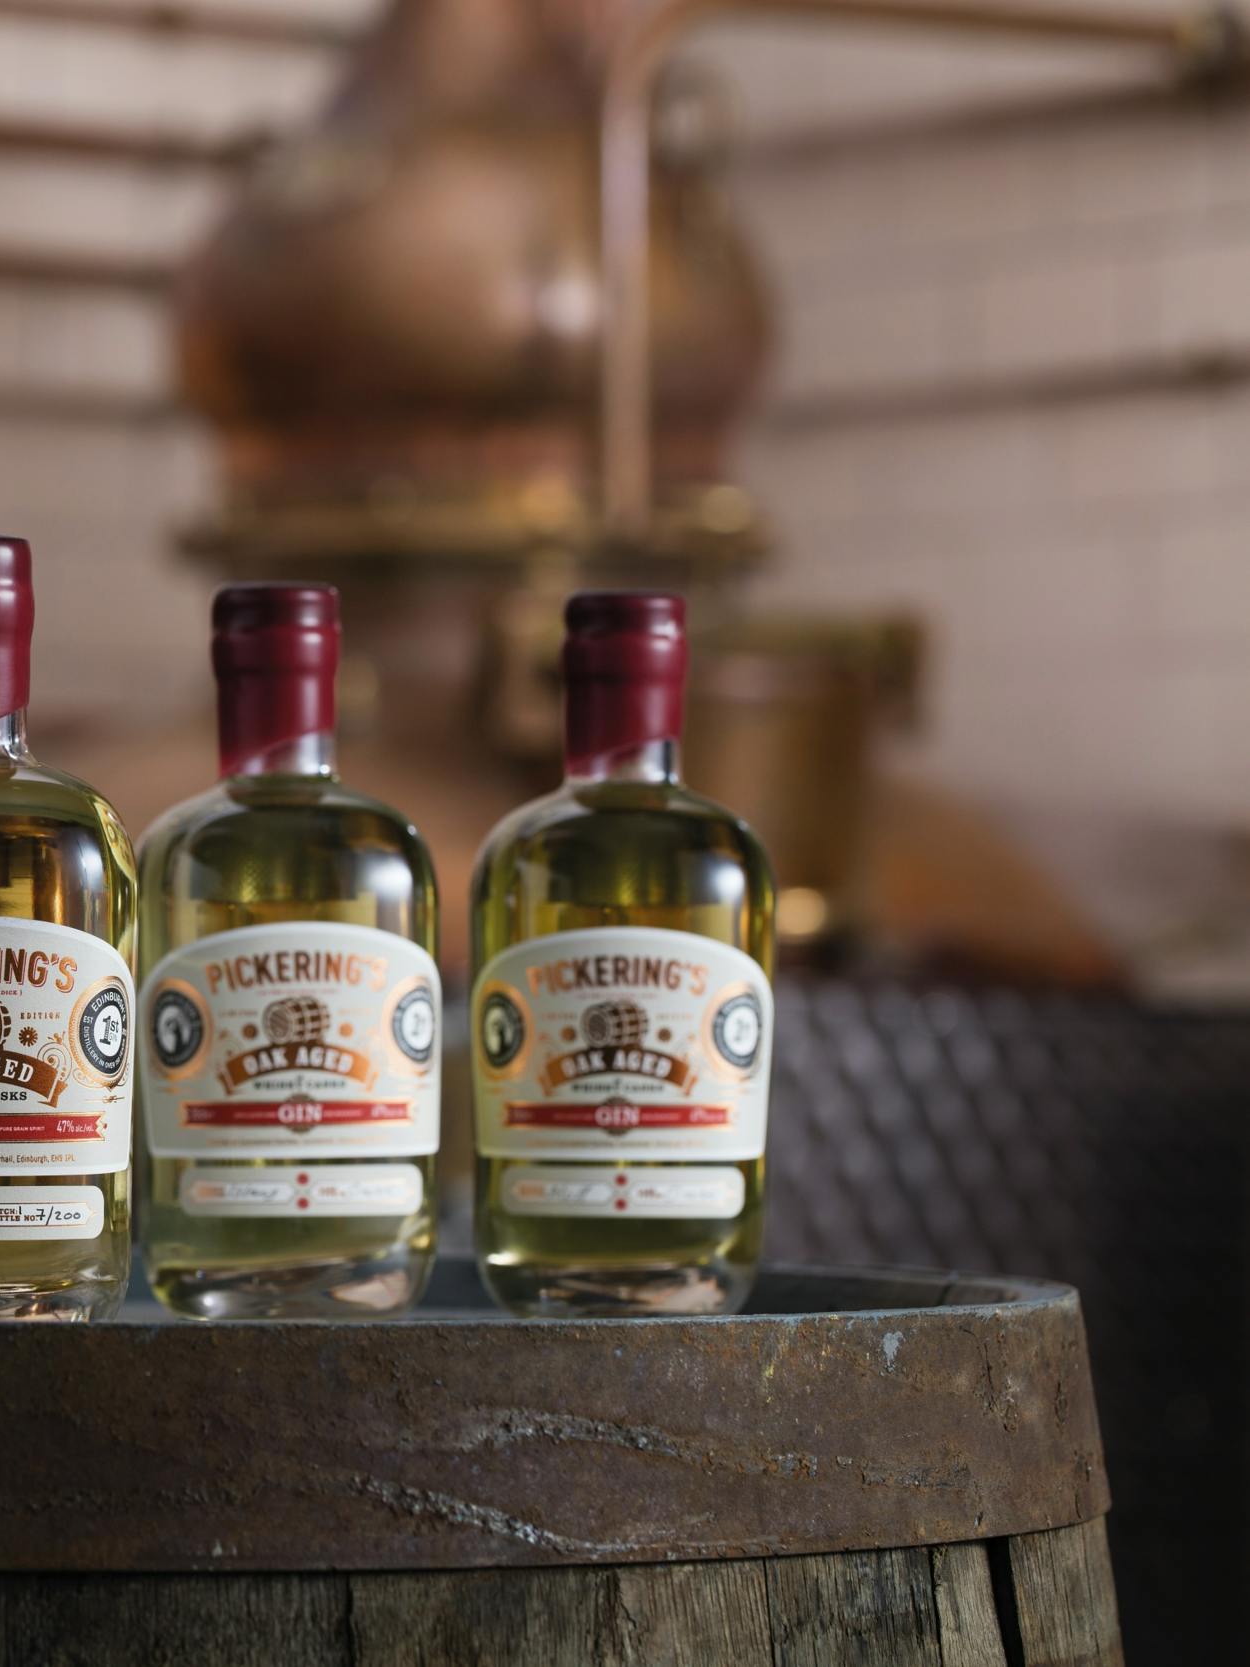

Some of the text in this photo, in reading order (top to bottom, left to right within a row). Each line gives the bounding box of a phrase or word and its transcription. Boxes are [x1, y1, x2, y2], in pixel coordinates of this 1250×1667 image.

[205, 950, 388, 994] PICKERING'S
[526, 955, 710, 996] PICKERING'S
[20, 1011, 61, 1020] EDITION
[243, 1046, 354, 1075] OAK AGED
[560, 1050, 673, 1078] OAK AGED
[277, 1103, 324, 1124] GIN
[595, 1106, 641, 1127] GIN
[56, 1120, 75, 1133] 47%
